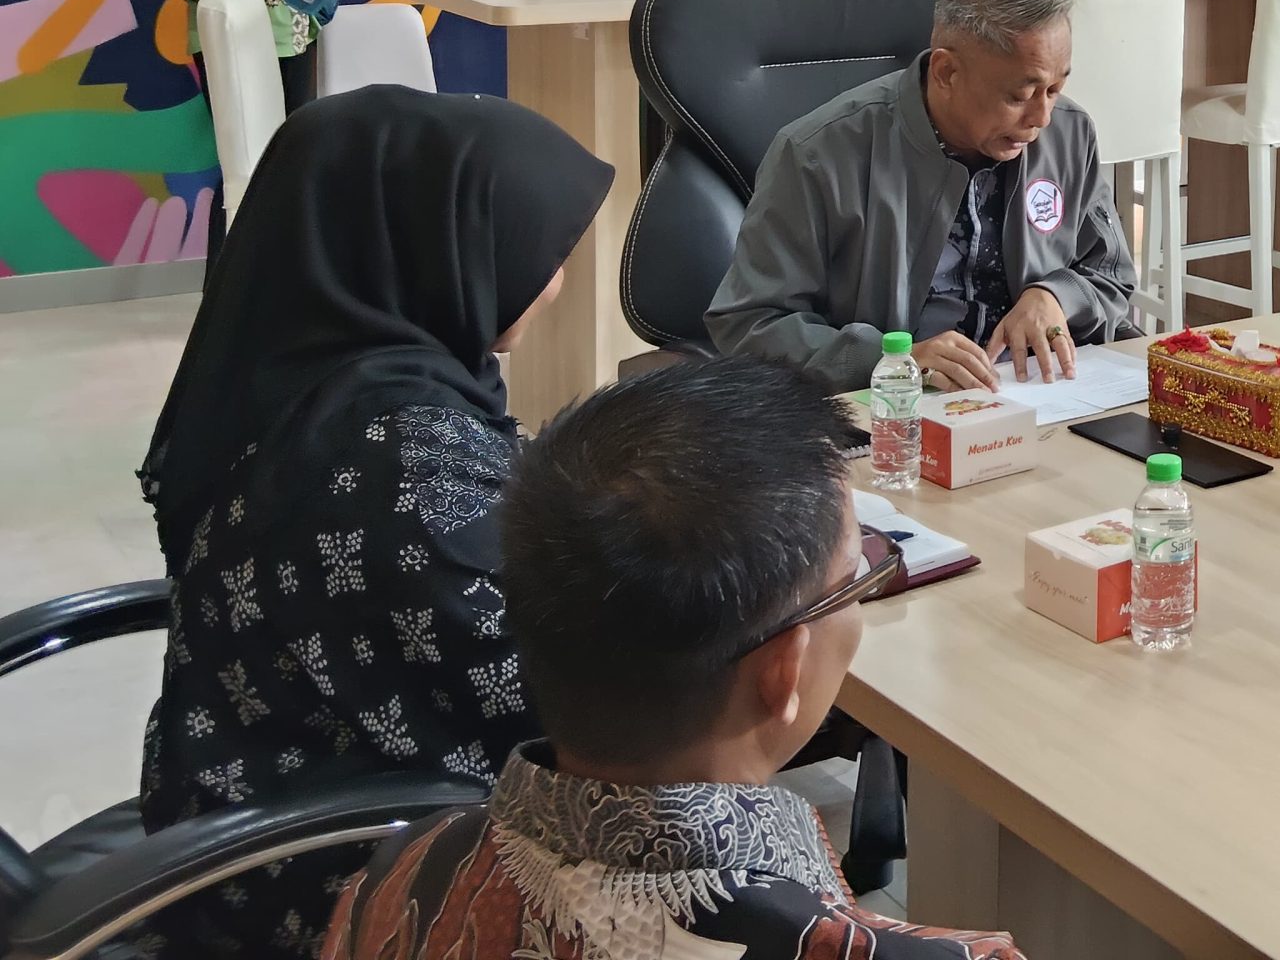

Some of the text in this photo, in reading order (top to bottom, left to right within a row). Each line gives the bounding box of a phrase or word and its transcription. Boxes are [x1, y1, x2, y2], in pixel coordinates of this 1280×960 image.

[967, 435, 1023, 456] Menata Kue
[1170, 537, 1193, 553] Sant
